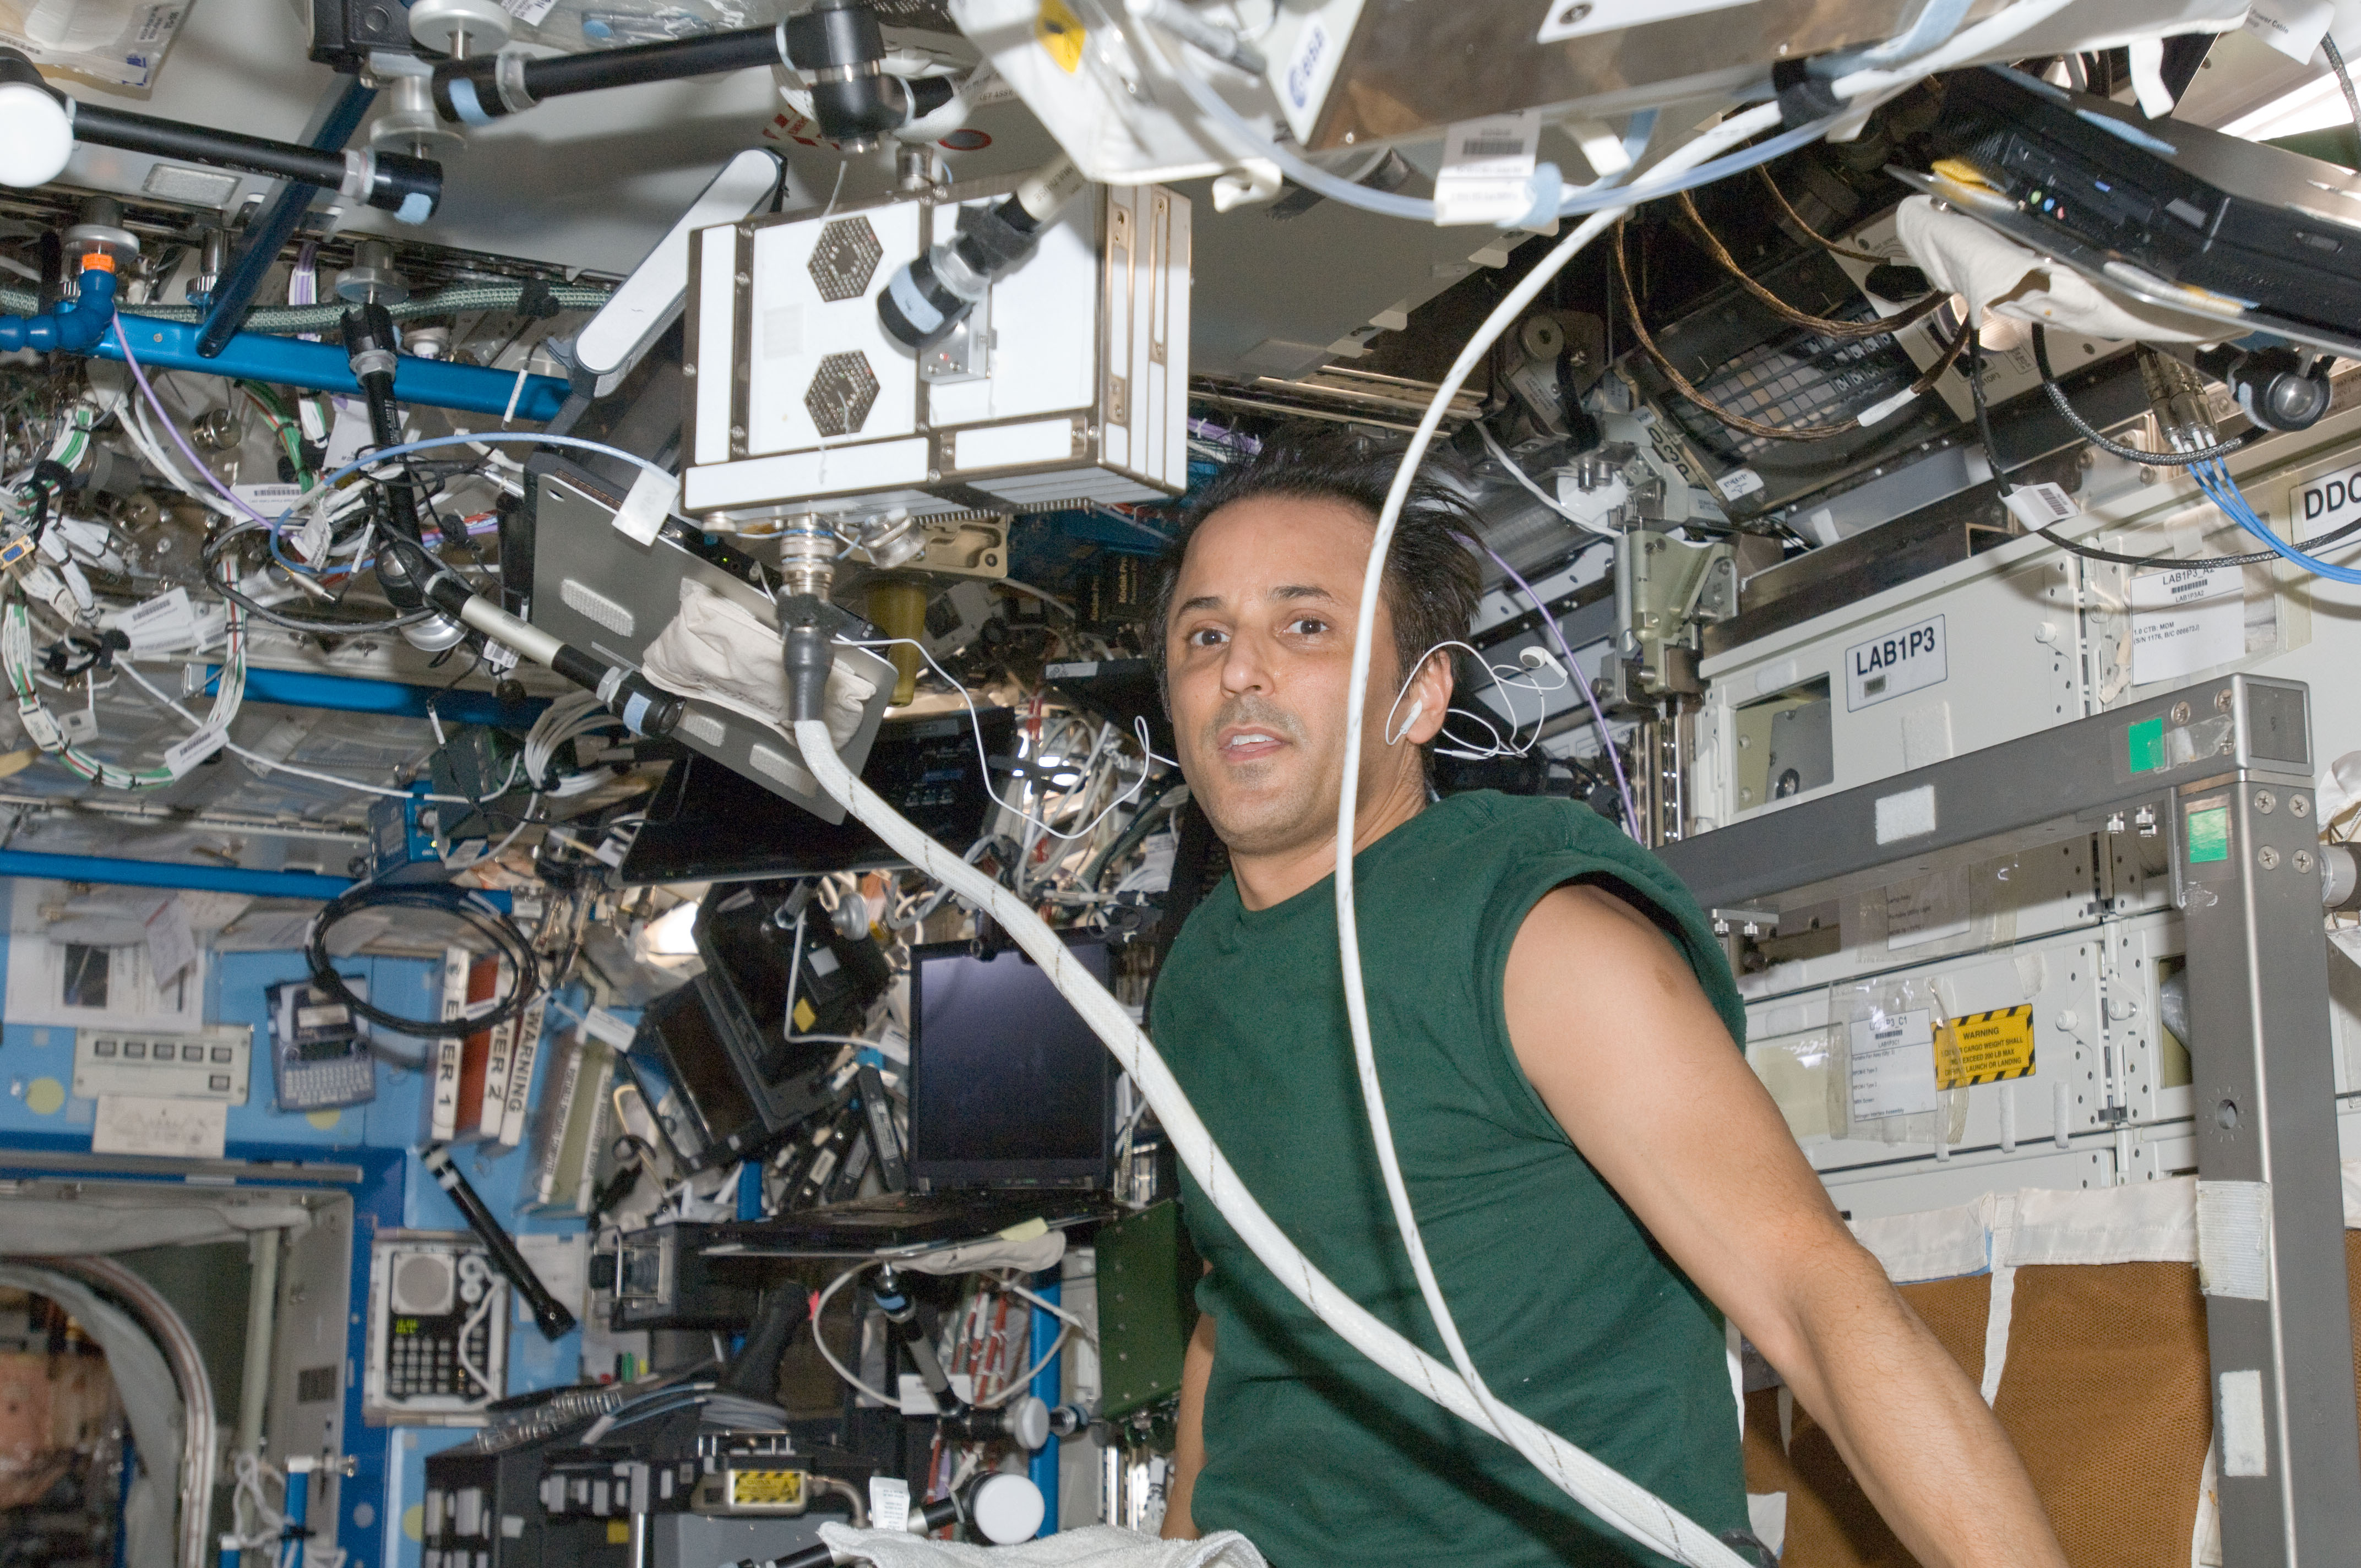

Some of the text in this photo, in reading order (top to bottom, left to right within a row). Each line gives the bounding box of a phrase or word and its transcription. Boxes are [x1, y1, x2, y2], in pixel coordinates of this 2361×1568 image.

[2272, 20, 2289, 34] Cable
[2175, 590, 2205, 603] LAB1P3A2
[2159, 621, 2174, 630] MDM
[1857, 626, 1935, 676] LAB1P3
[439, 999, 460, 1081] EER
[1963, 1027, 1999, 1041] WARNING
[1963, 1043, 1983, 1053] CARGO
[1983, 1040, 2004, 1049] WEIGHT
[2005, 1037, 2023, 1046] SHALL
[508, 1011, 541, 1113] WARNING
[1962, 1054, 1984, 1064] EXCEED
[1984, 1052, 1994, 1060] 200
[1966, 1063, 1988, 1072] LAUNCH
[1997, 1057, 2021, 1067] LANDING
